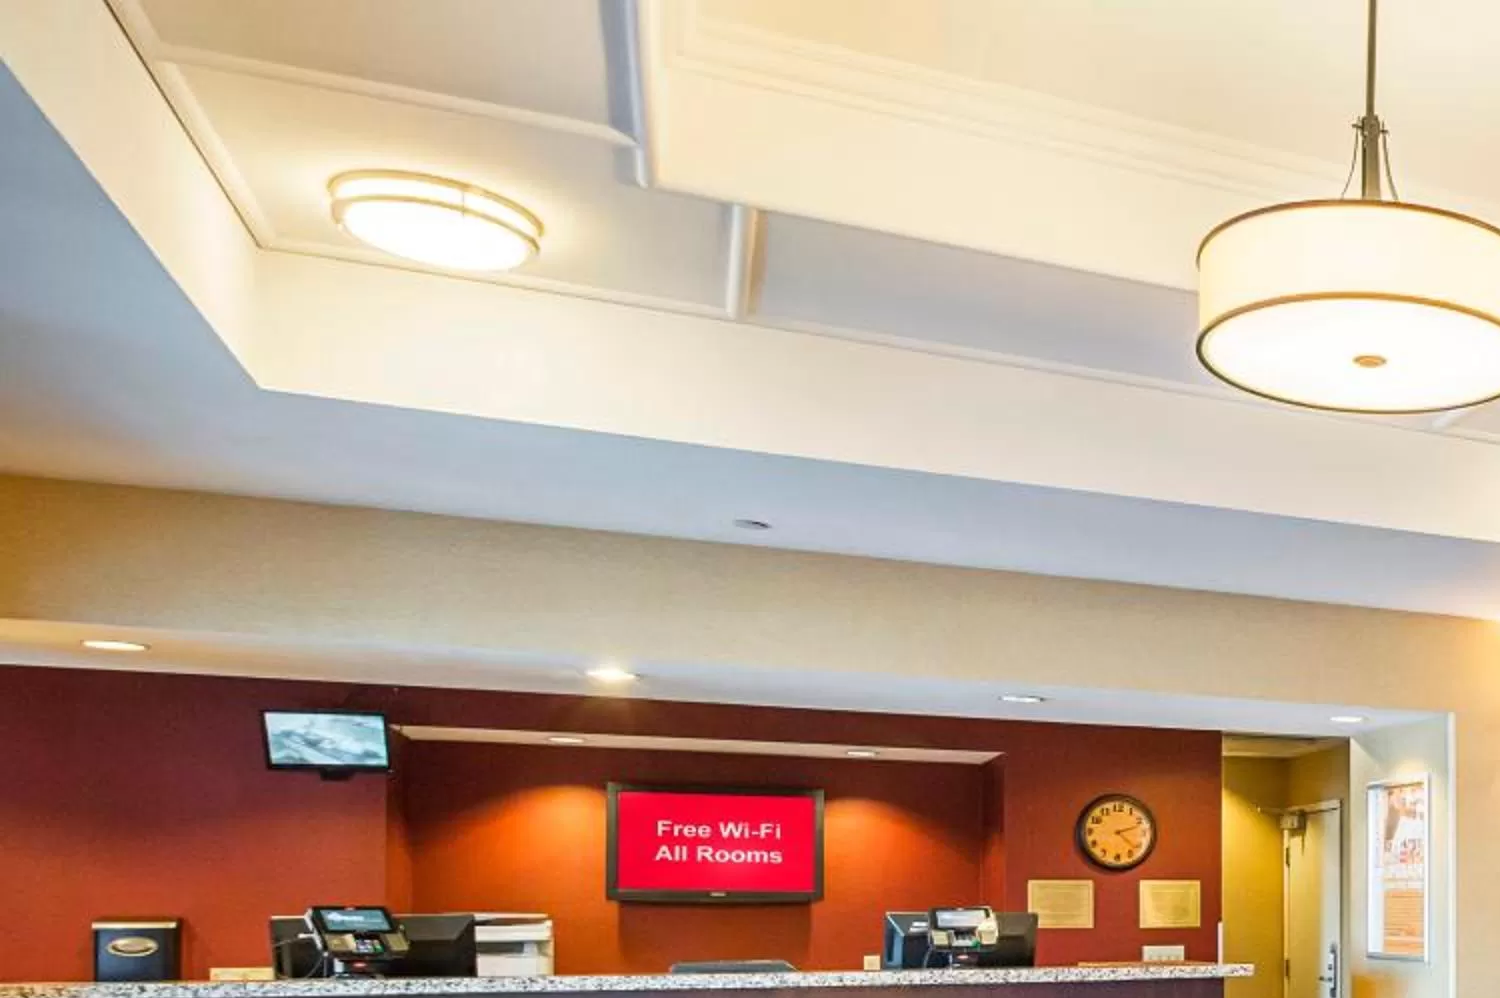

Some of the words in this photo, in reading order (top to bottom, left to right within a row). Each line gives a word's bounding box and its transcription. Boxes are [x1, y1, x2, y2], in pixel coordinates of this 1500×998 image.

[656, 820, 711, 838] Free
[719, 821, 781, 840] Wi-Fi
[655, 845, 687, 862] All
[696, 845, 783, 864] Rooms
